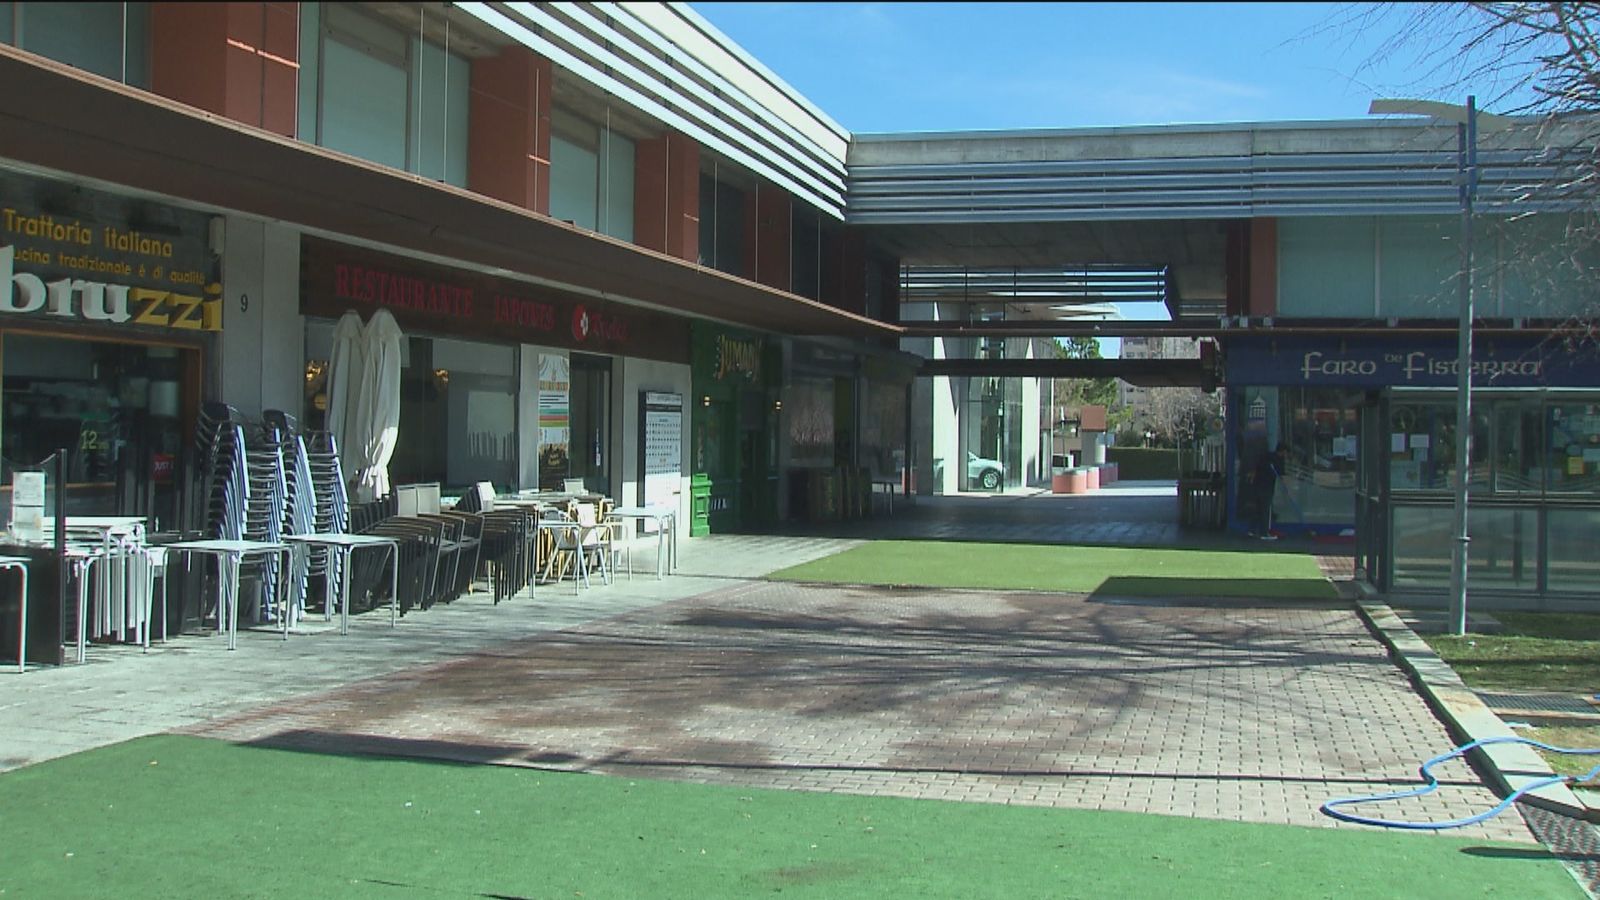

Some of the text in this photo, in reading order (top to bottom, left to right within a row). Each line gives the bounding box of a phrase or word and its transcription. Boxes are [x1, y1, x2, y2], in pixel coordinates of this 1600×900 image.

[4, 208, 173, 257] Trattoria italiana
[59, 251, 131, 276] tradizionale
[240, 293, 249, 313] 9
[335, 263, 473, 317] RESTAURANTE
